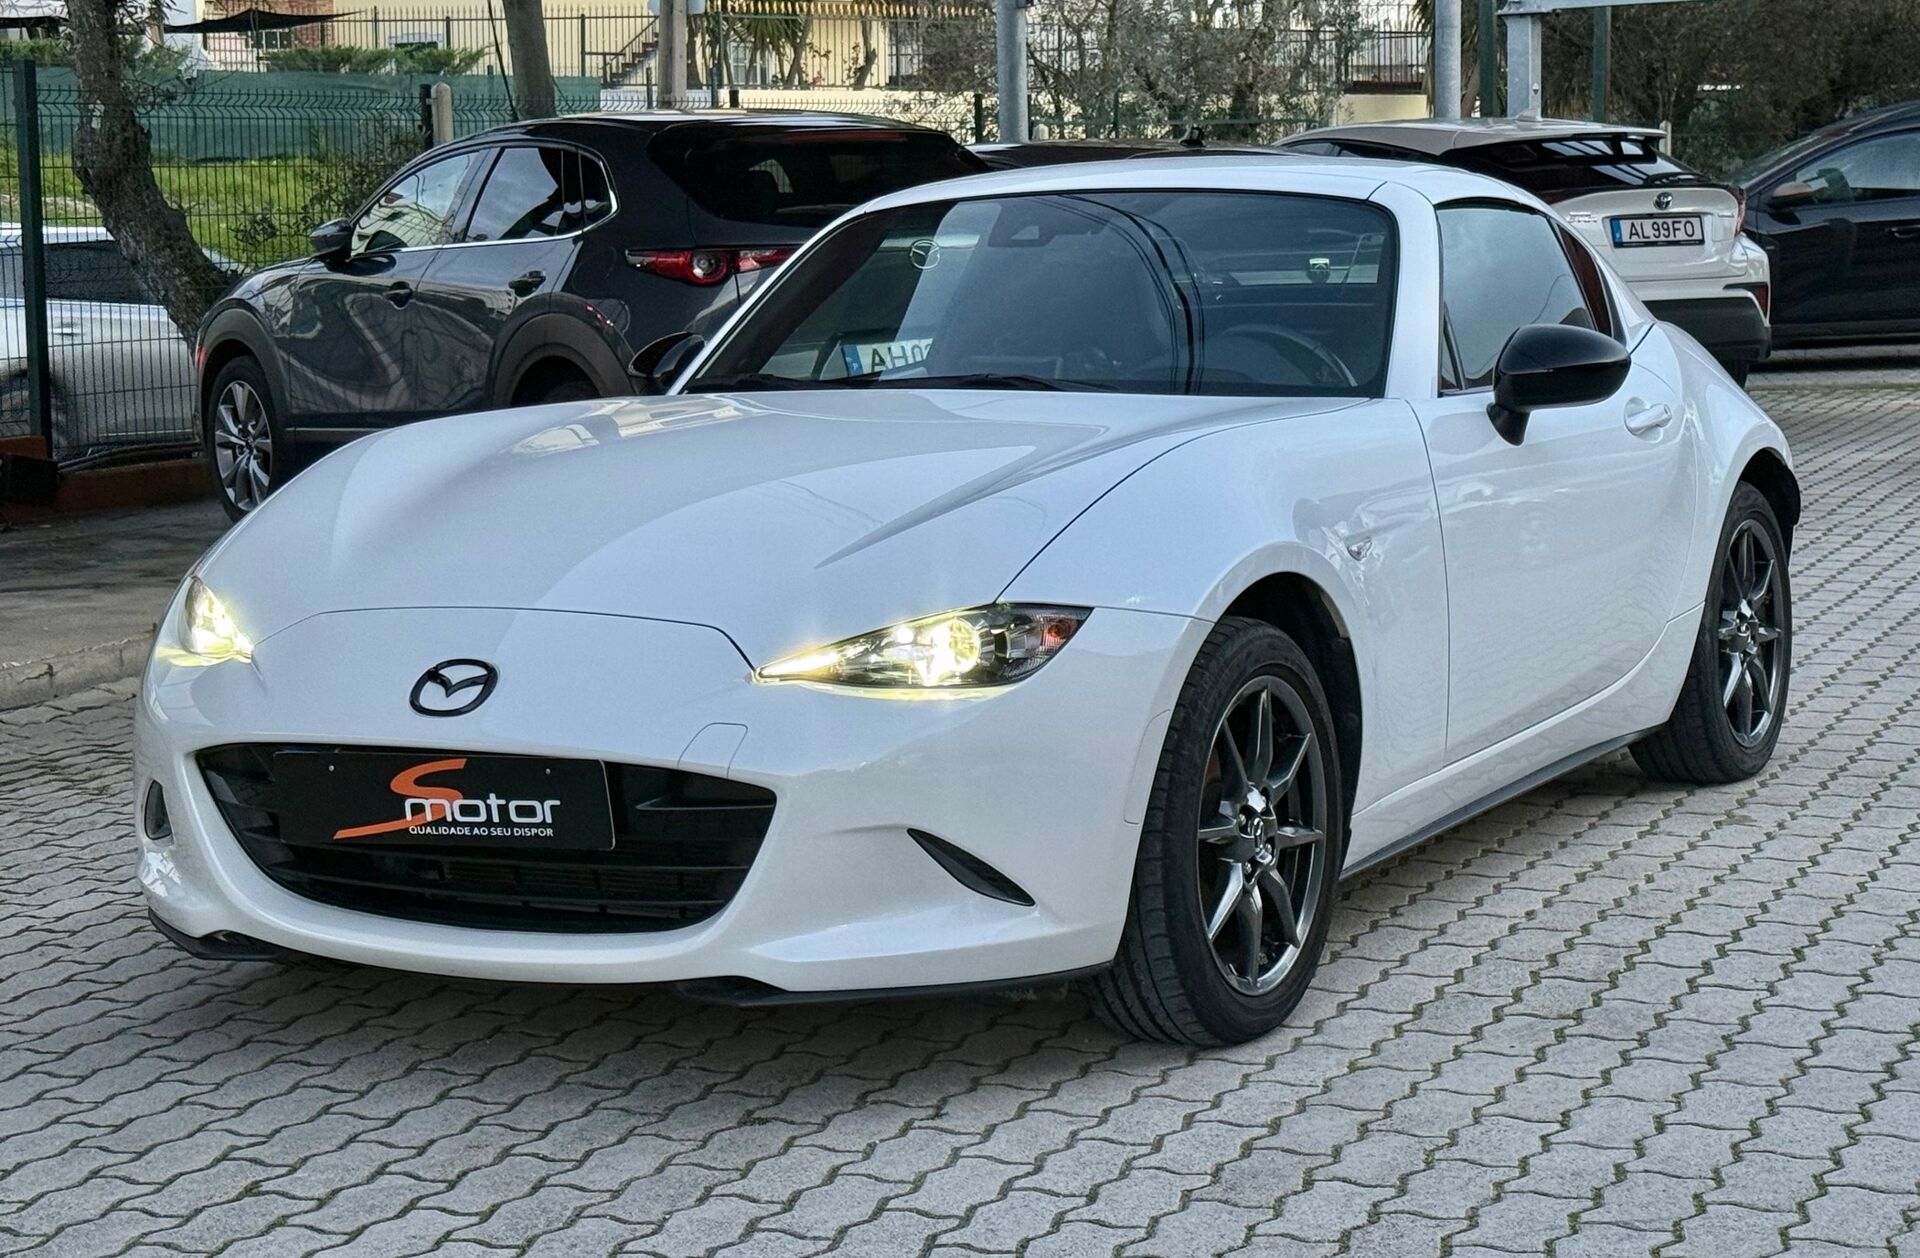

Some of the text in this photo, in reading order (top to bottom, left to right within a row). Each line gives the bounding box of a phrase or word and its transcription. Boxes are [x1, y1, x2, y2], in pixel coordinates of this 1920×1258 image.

[408, 825, 554, 837] QUALIDADE AO SEU DISPOR
